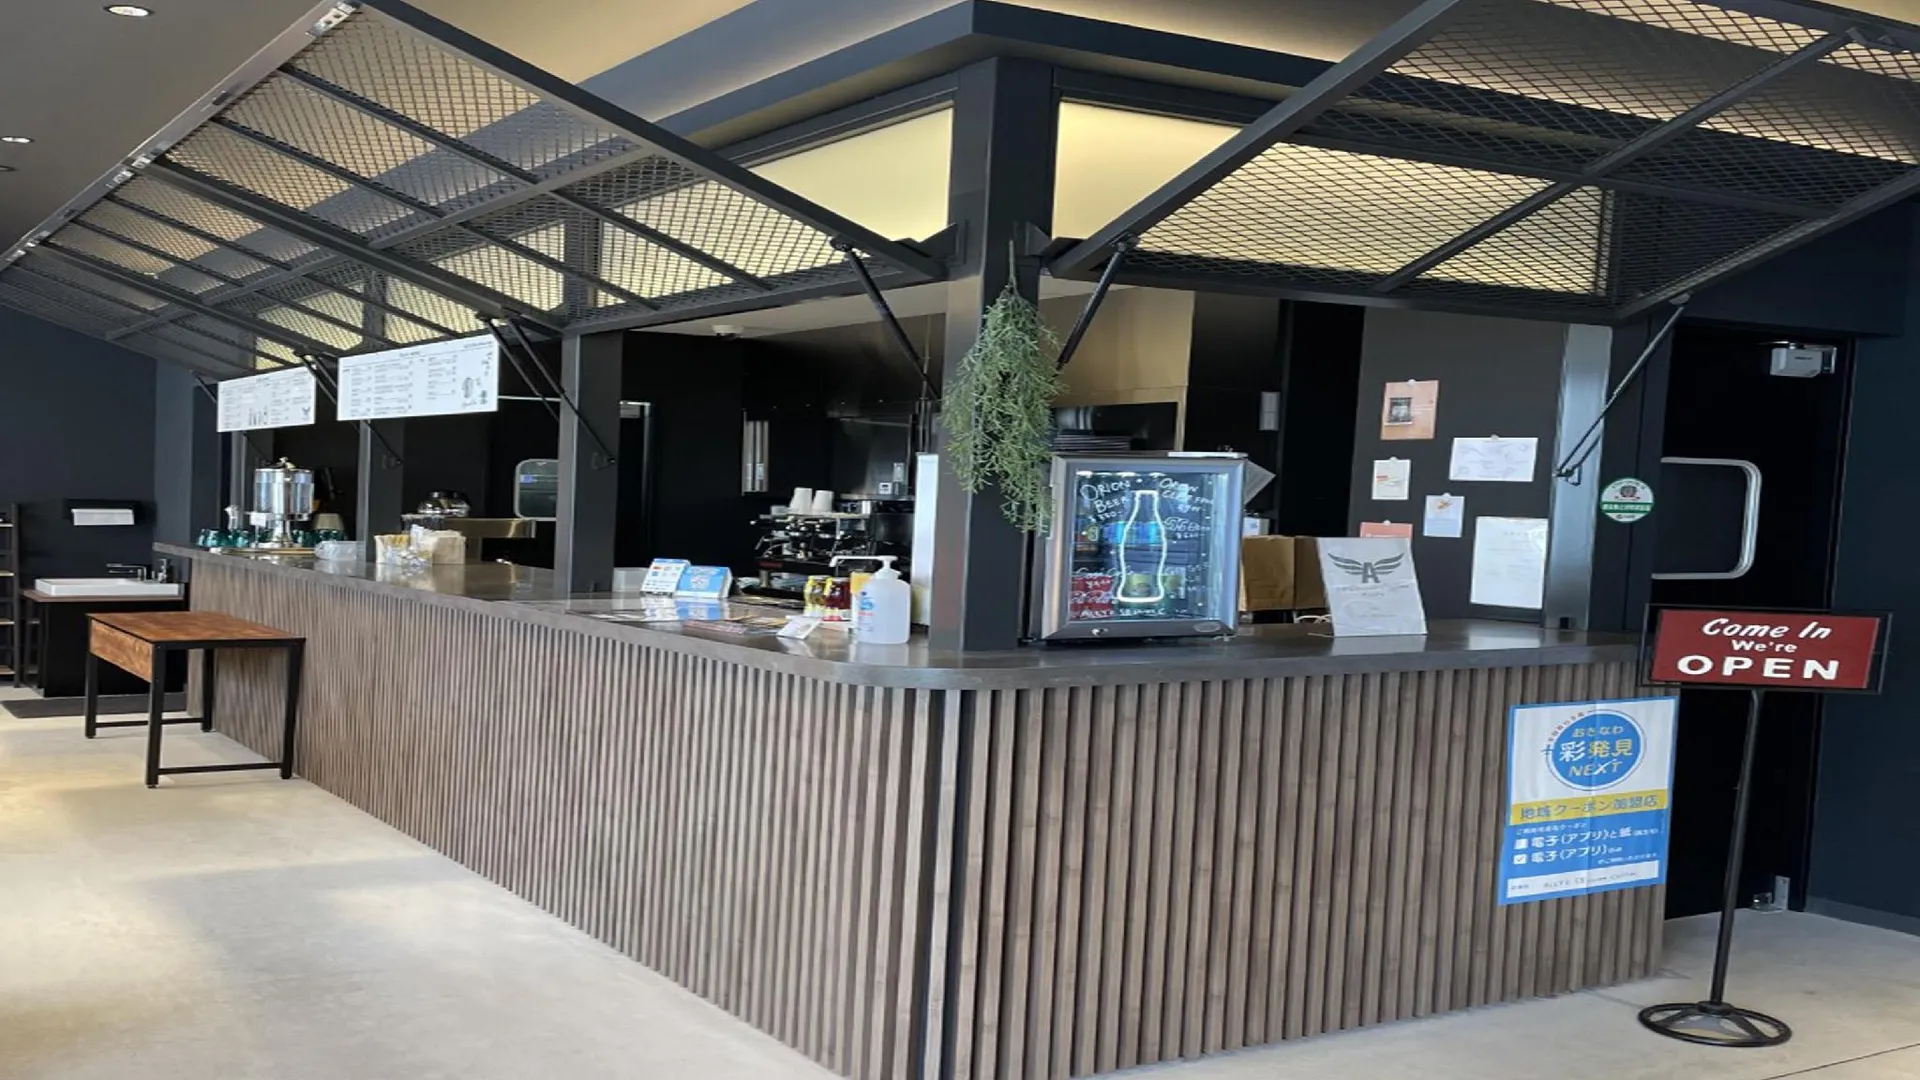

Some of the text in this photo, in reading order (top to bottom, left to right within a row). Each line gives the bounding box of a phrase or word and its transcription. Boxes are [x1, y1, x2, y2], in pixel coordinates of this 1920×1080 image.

[1702, 617, 1833, 639] Come In
[1731, 639, 1798, 653] We're
[1677, 655, 1840, 680] OPEN
[1572, 725, 1625, 738] おきなわ
[1559, 738, 1633, 762] 彩発見
[1568, 759, 1623, 777] NEXT
[1520, 794, 1658, 820] 地域クーポン加盟店
